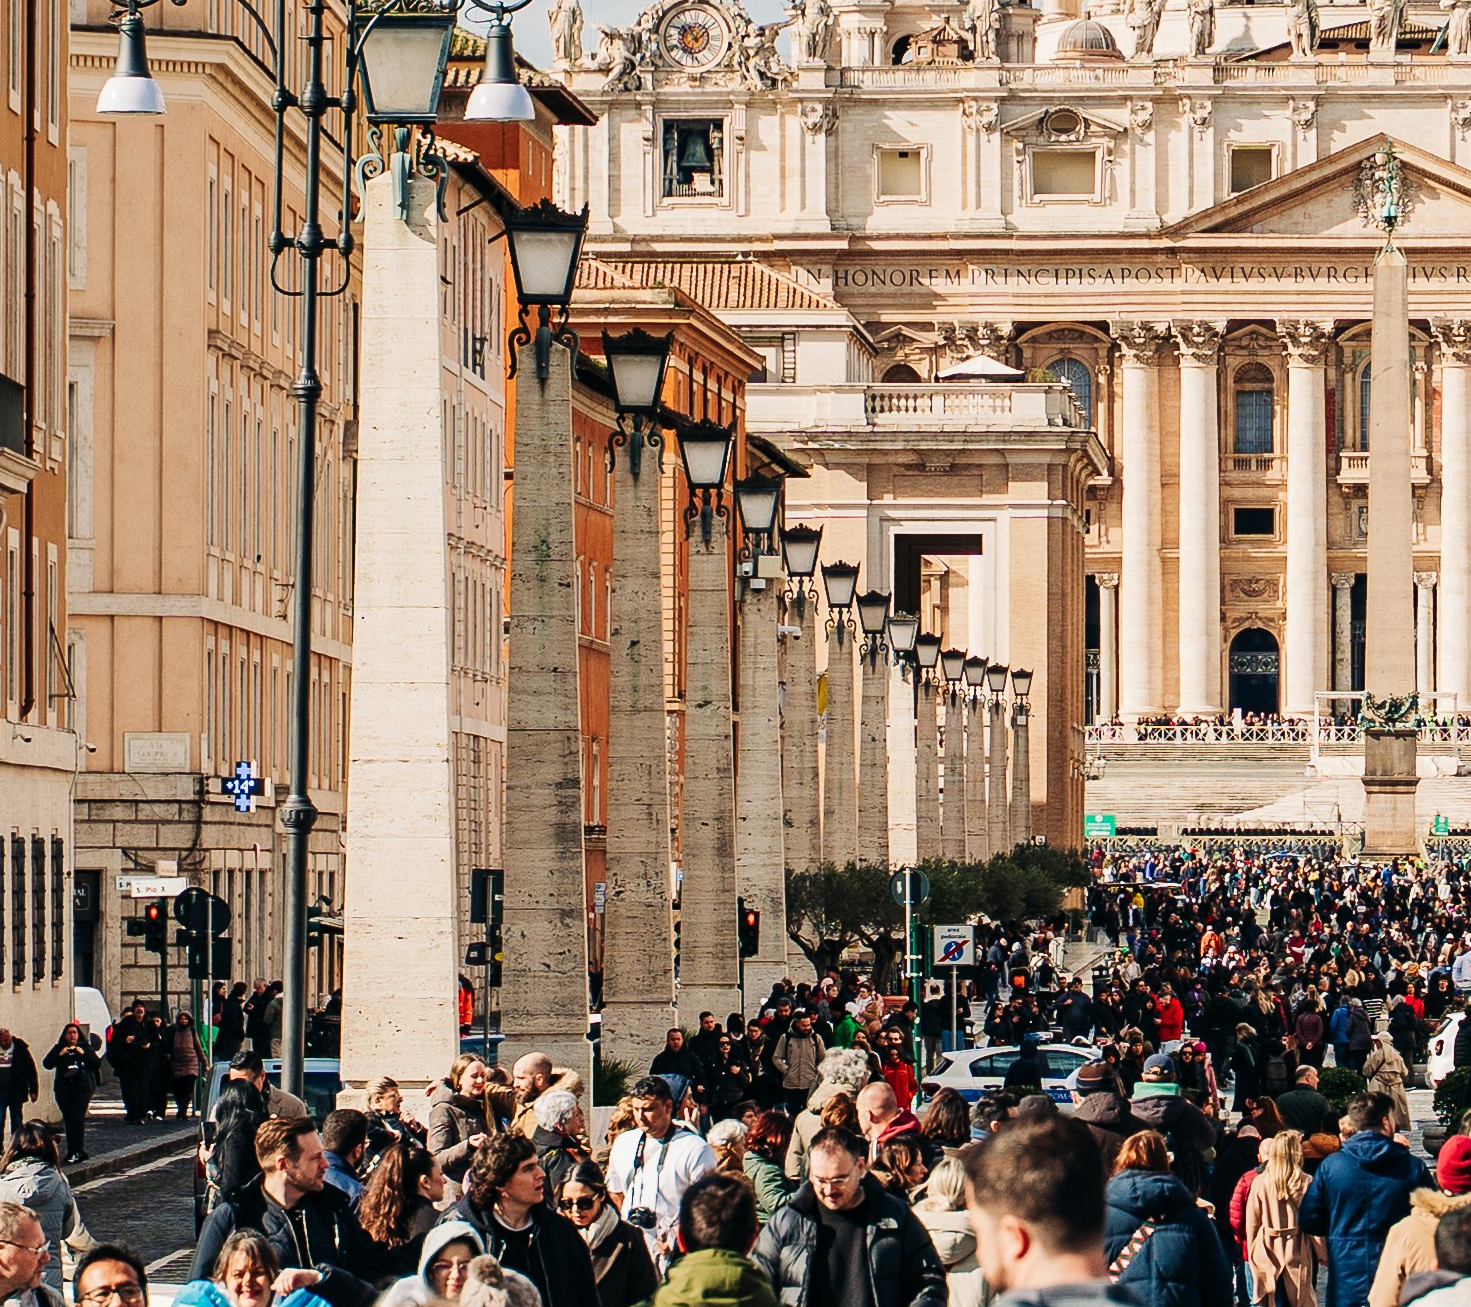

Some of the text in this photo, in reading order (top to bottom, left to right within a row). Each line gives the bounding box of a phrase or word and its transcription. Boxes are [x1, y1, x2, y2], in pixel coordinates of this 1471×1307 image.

[794, 268, 822, 285] IN
[834, 268, 962, 287] HONOREM
[971, 267, 1097, 285] PRINCIPIS
[1102, 267, 1180, 285] APOST
[1184, 266, 1267, 284] PAVLVS
